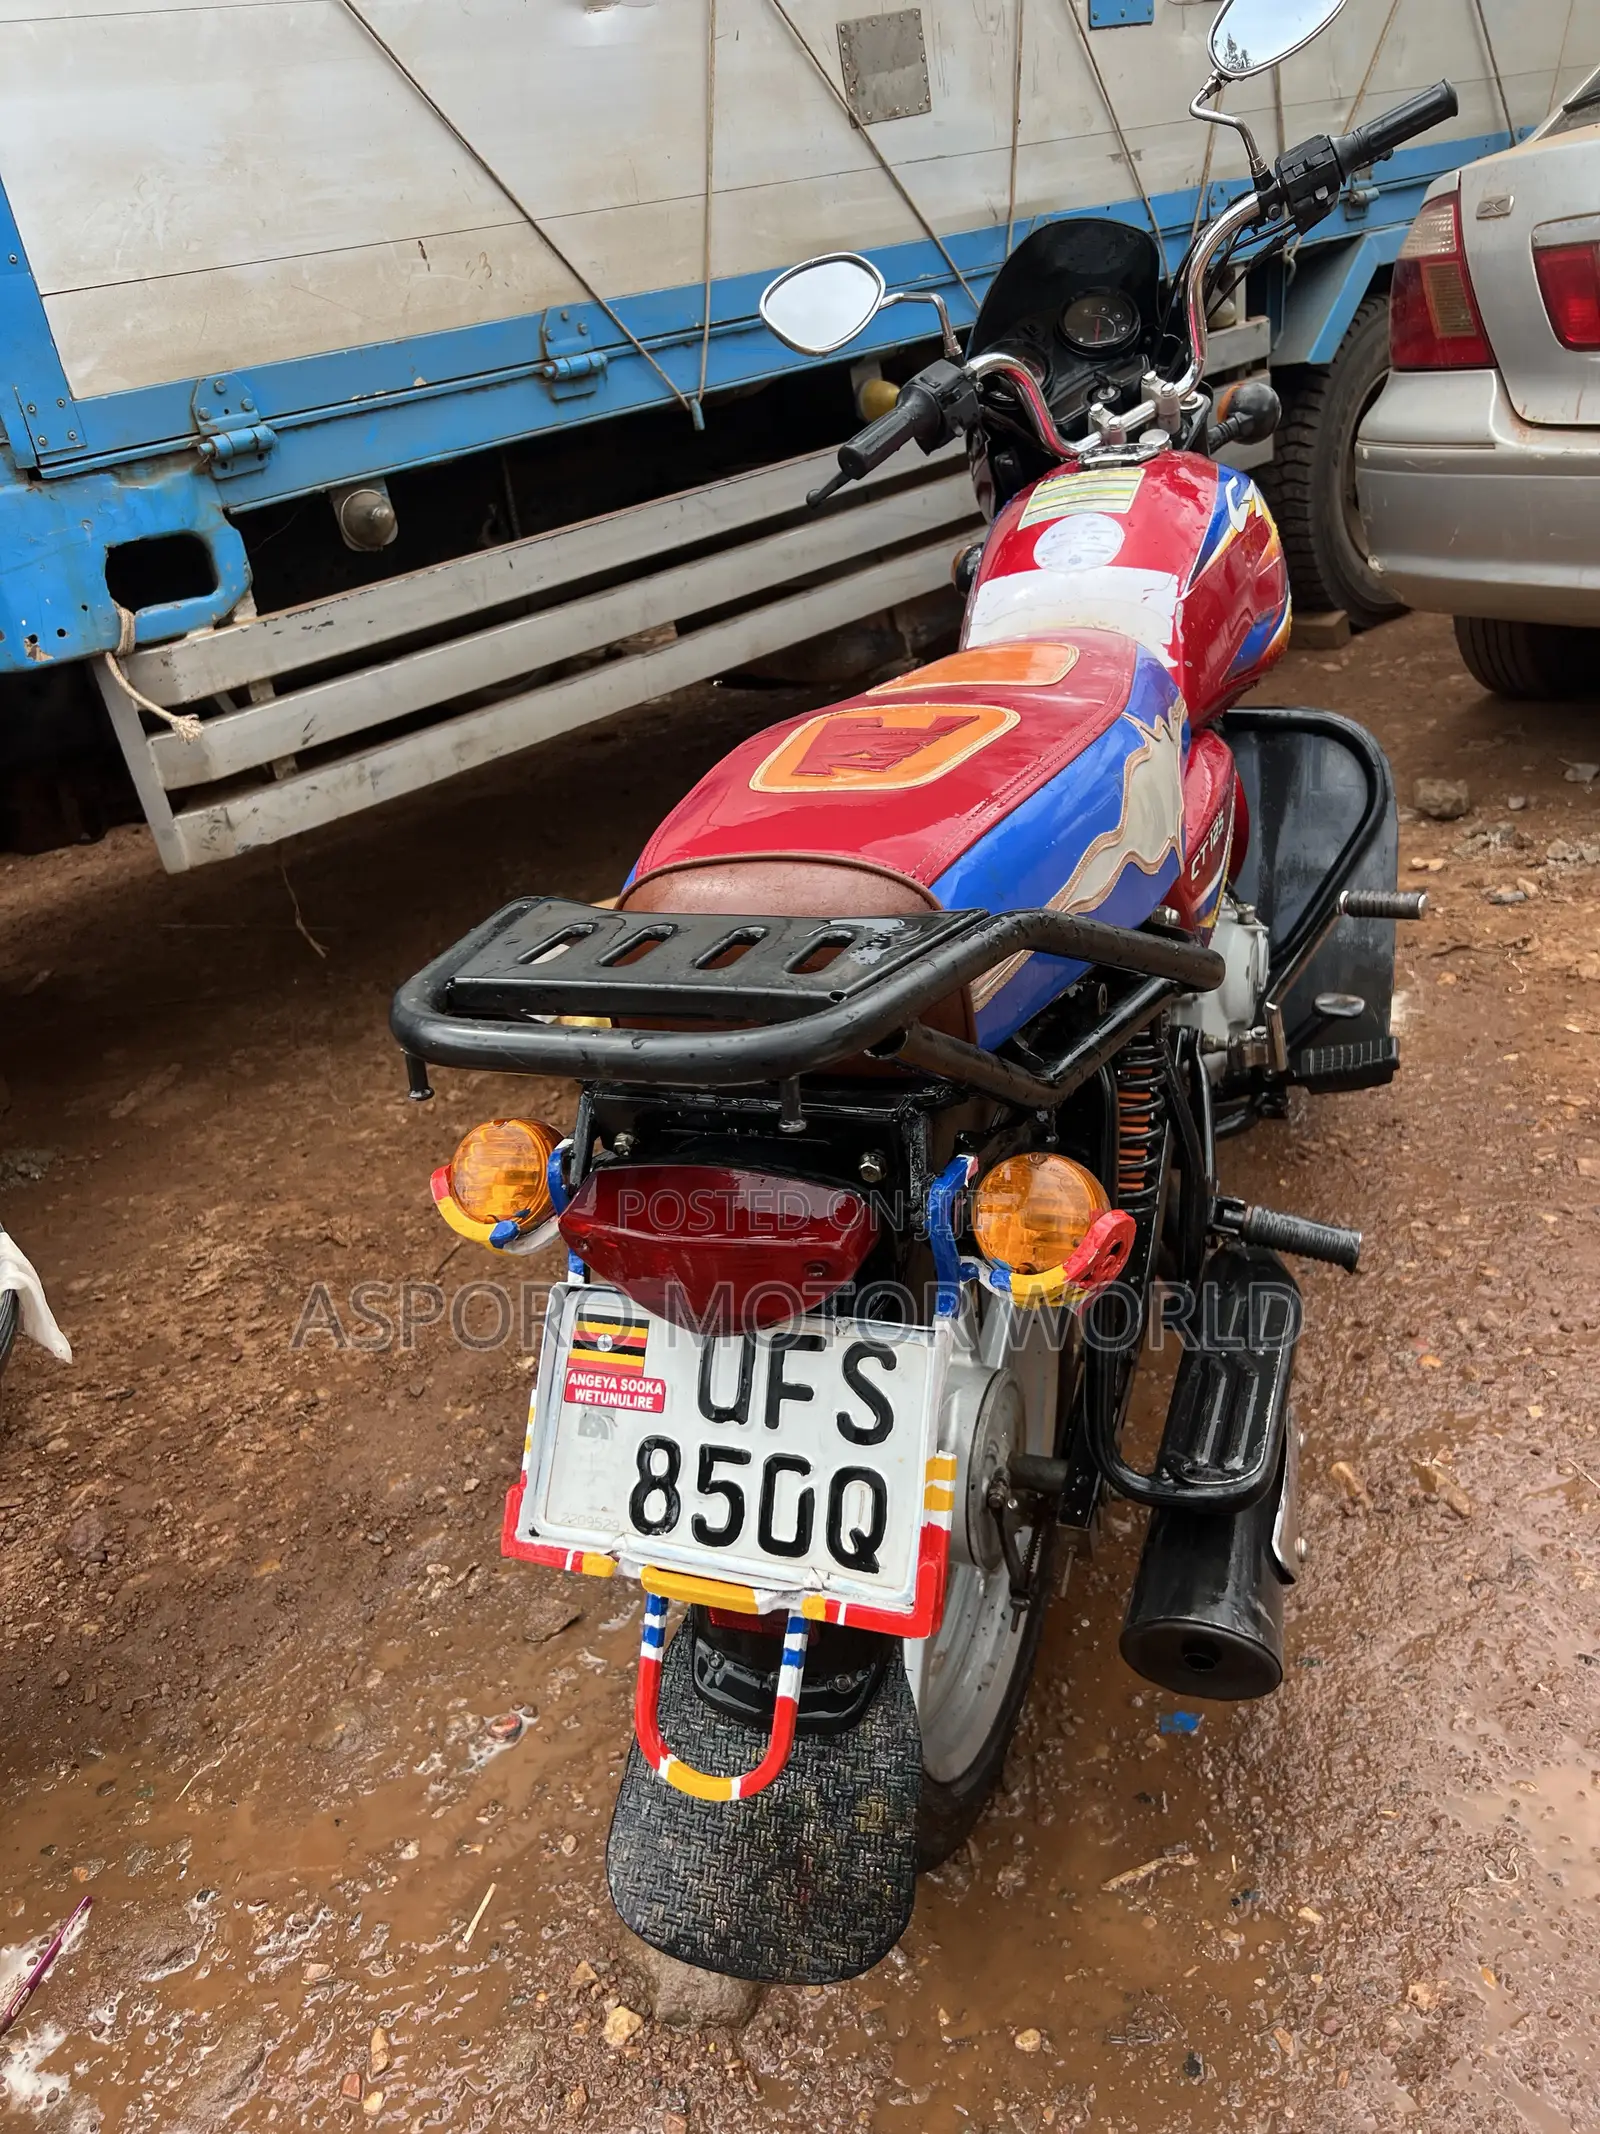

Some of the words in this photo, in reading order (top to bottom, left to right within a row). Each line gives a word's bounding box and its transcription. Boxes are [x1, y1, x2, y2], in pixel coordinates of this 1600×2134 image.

[1191, 840, 1209, 881] CT
[568, 1373, 617, 1390] ANGEYA
[620, 1379, 663, 1395] SOOKA
[574, 1388, 654, 1409] WETUNULIRE
[698, 1332, 898, 1446] UFS
[629, 1435, 888, 1574] 850Q
